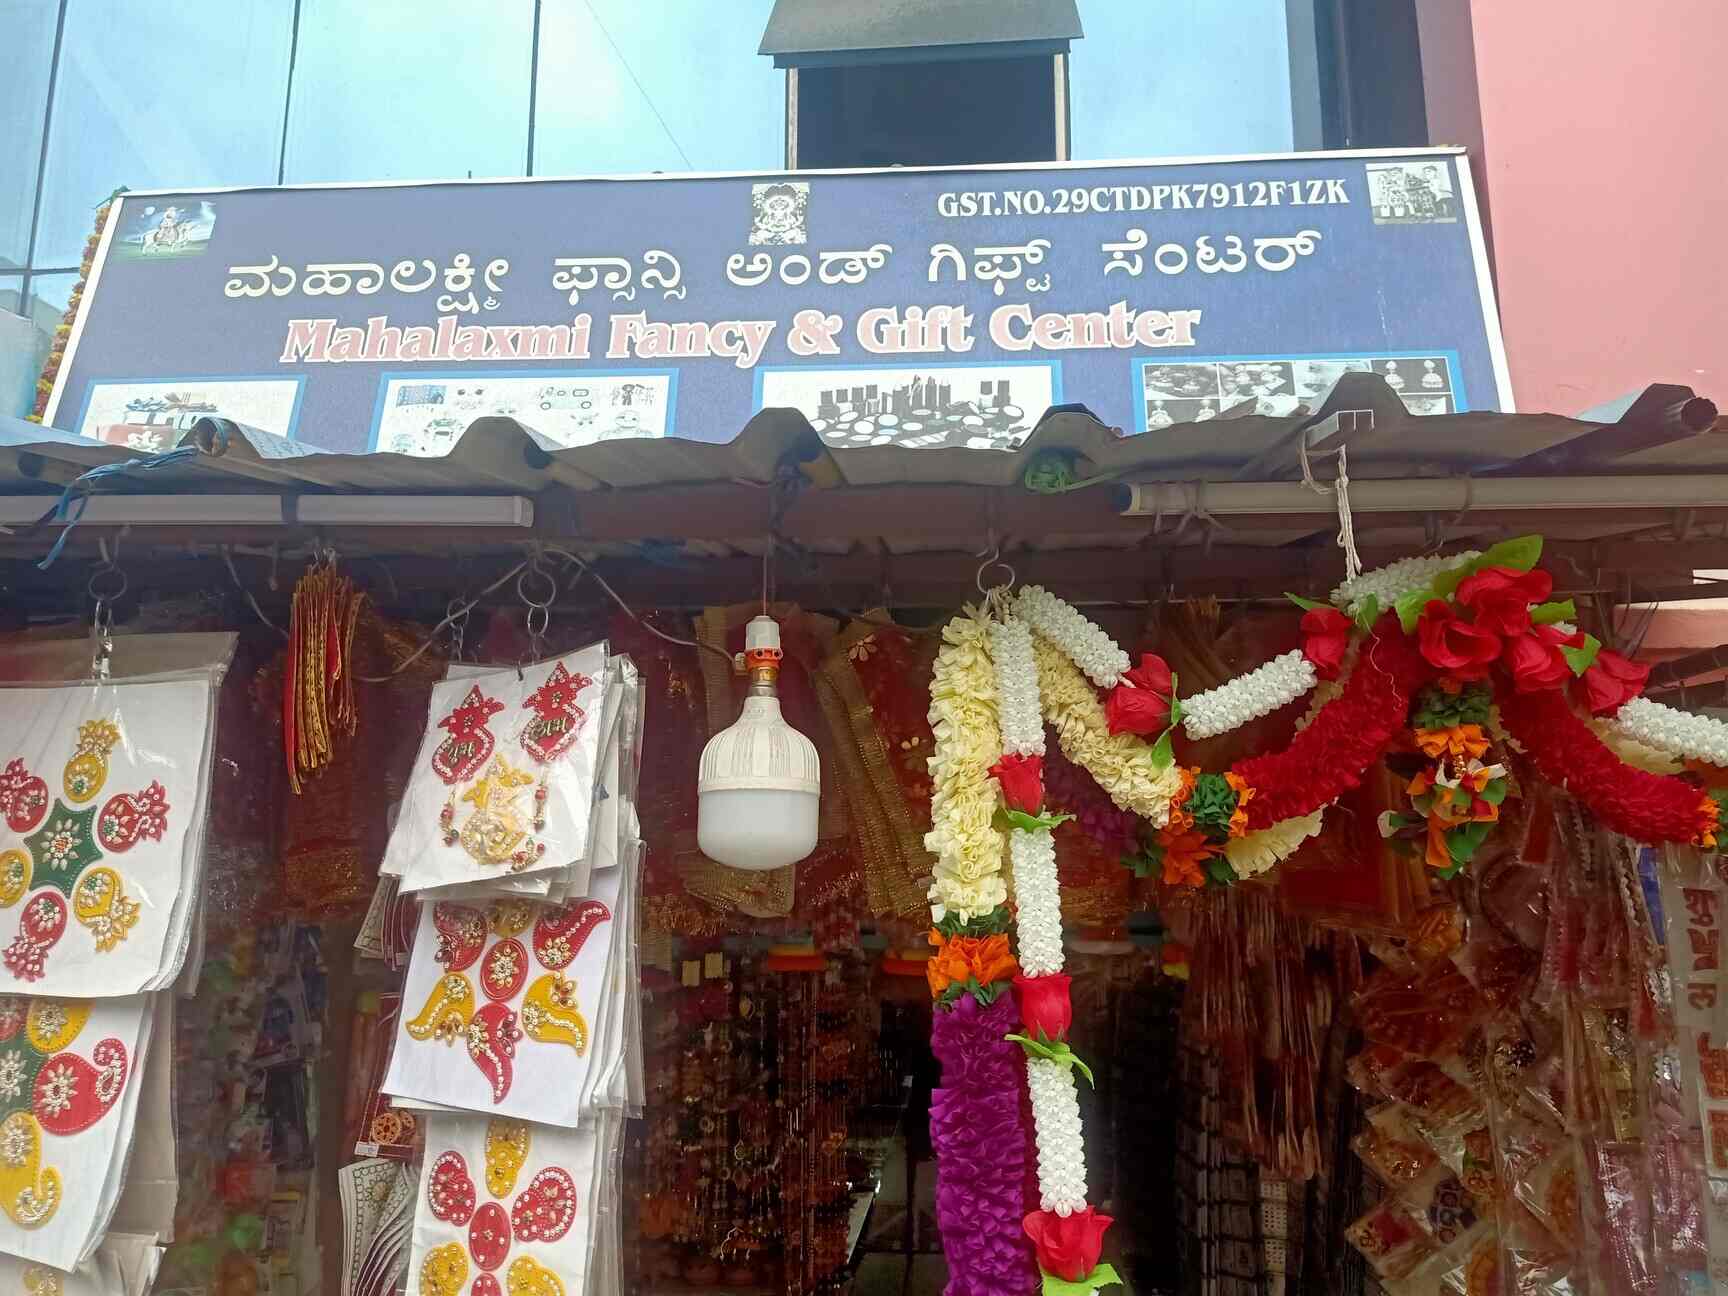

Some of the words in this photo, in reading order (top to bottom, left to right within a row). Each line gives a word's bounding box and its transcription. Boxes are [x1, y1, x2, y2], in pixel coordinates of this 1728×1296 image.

[937, 179, 1350, 218] GST.NO.29CTDPK7912F1ZK
[726, 244, 893, 286] ಅಂಡ್
[928, 239, 1052, 296] ಗಿಫ್ಟ್
[1101, 228, 1322, 276] ಸೆಂಟರ್
[279, 313, 593, 363] Mahalaxmi
[606, 310, 777, 369] Fancy
[787, 309, 844, 356] &
[856, 304, 977, 353] Gift
[989, 300, 1202, 350] Center
